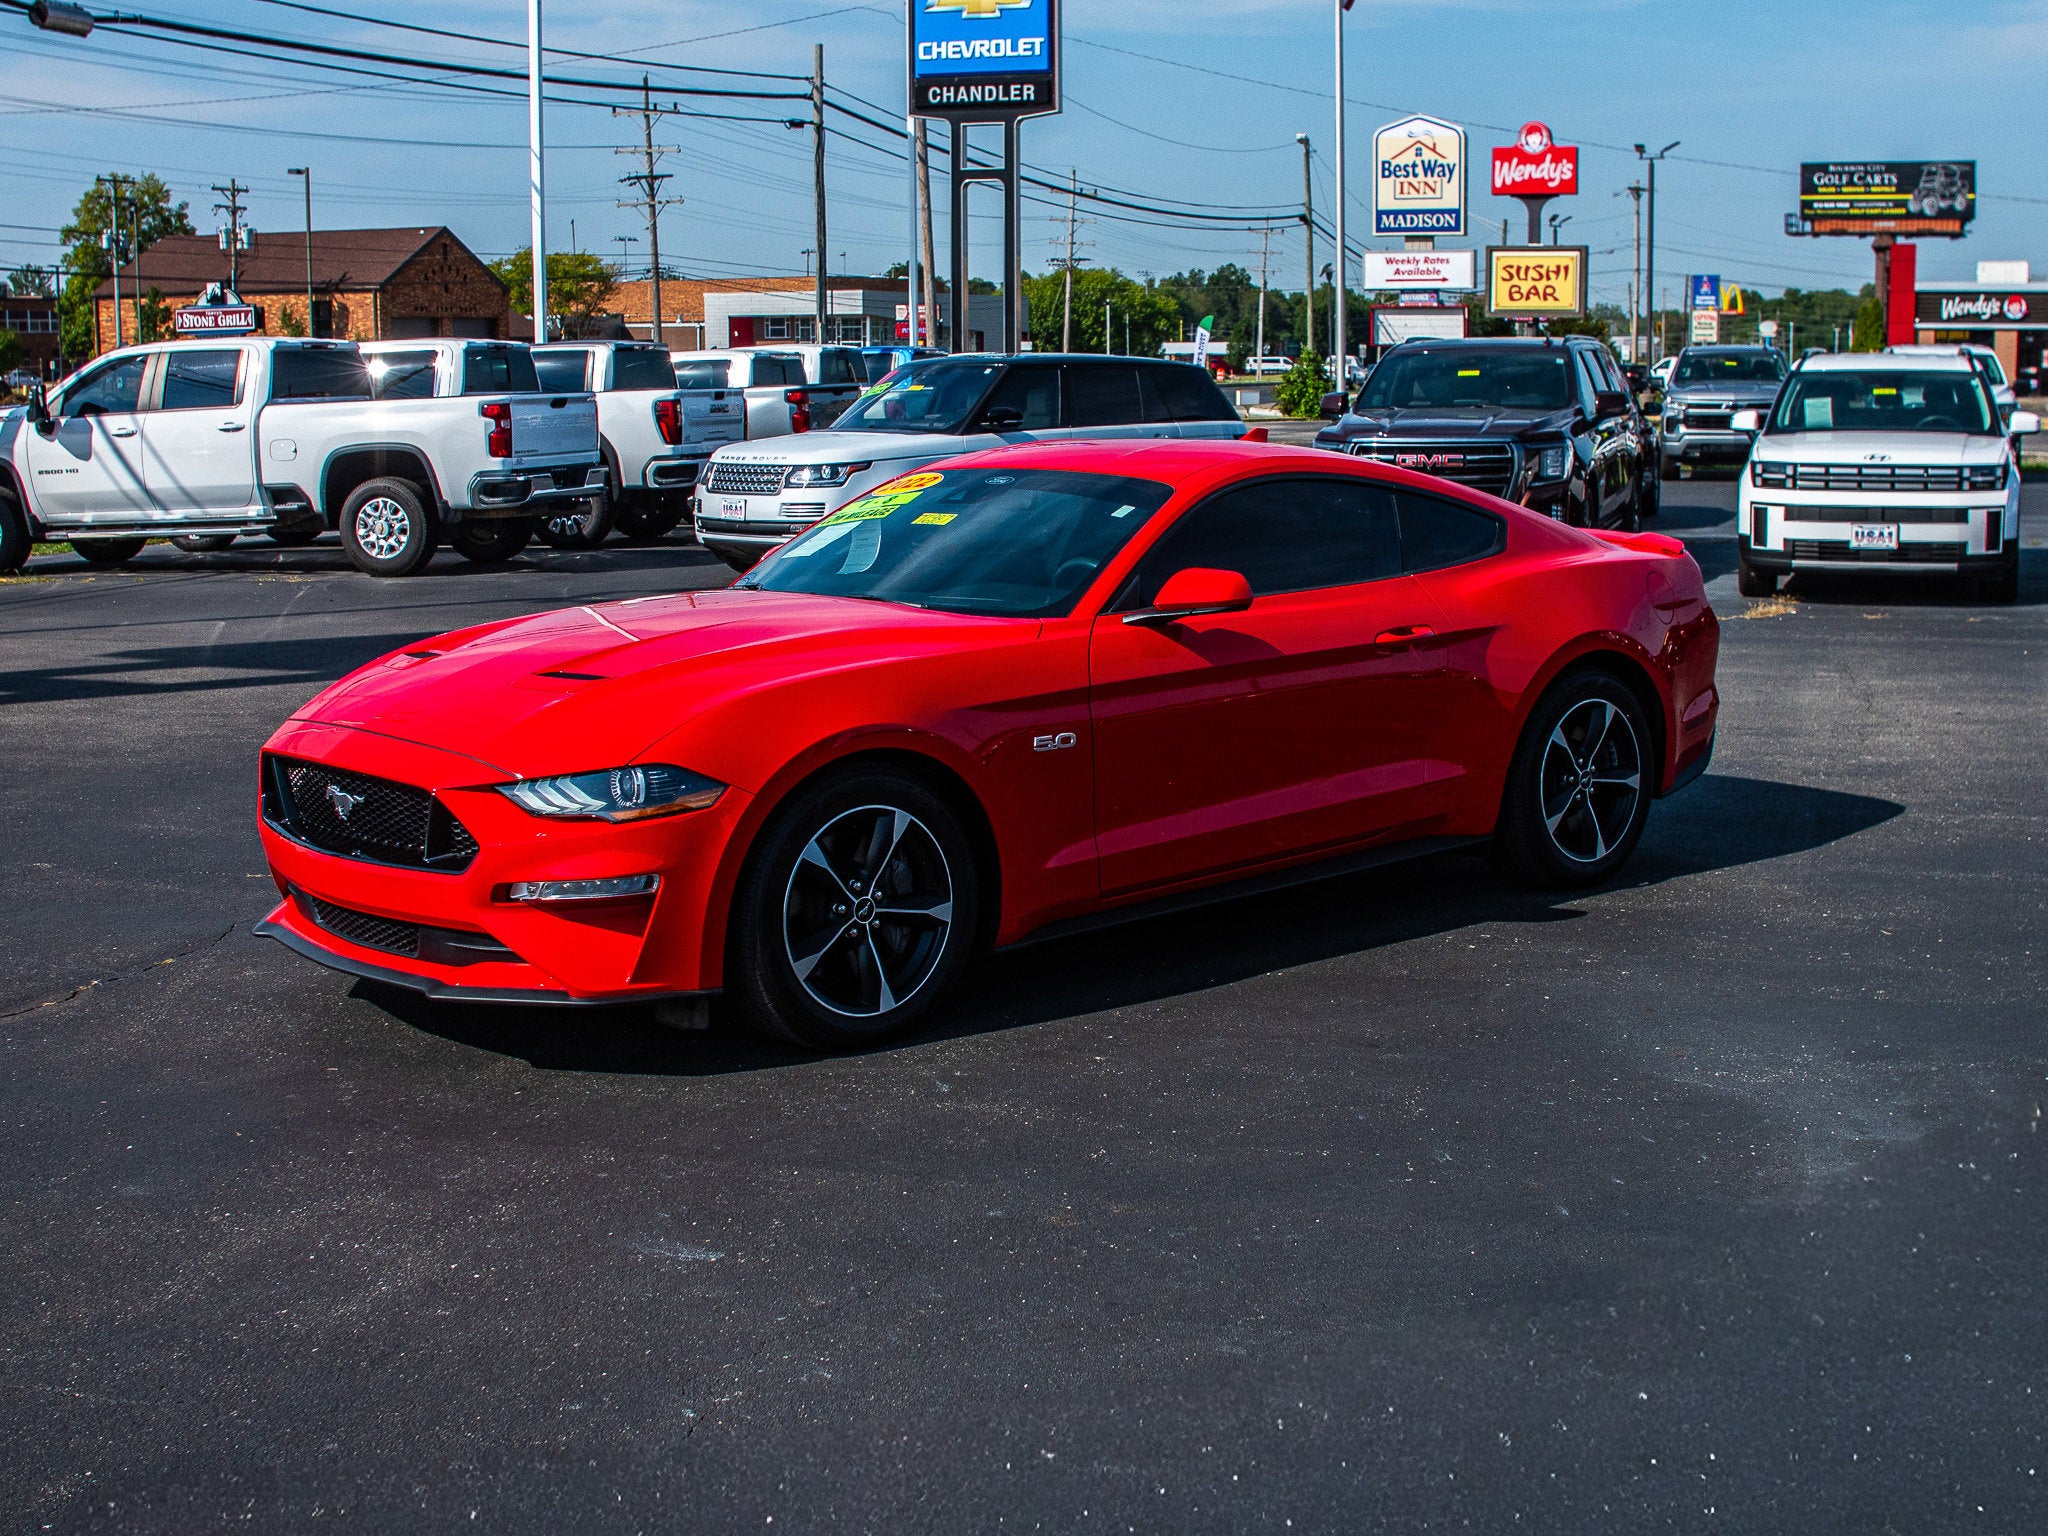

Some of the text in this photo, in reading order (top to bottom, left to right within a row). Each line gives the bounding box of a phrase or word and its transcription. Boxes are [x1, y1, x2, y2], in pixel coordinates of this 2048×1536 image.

[918, 37, 1045, 60] CHEVROLET
[928, 83, 1036, 103] CHANDLER
[1381, 159, 1457, 184] Best Way
[1494, 153, 1574, 188] Wendy's
[1813, 171, 1898, 186] GOLF CARTS
[1398, 181, 1438, 196] INN
[1381, 213, 1457, 229] MADISON
[1385, 256, 1451, 266] Weekly Rates
[1394, 267, 1442, 276] Available
[1501, 263, 1570, 282] SUSHI
[1508, 285, 1560, 302] BAR
[1941, 293, 2001, 320] Wendy's
[182, 312, 248, 328] STONE GRILL
[1396, 454, 1464, 467] GMC
[723, 504, 742, 516] USA1
[1854, 530, 1893, 544] USA1
[1033, 732, 1077, 751] 5.0
